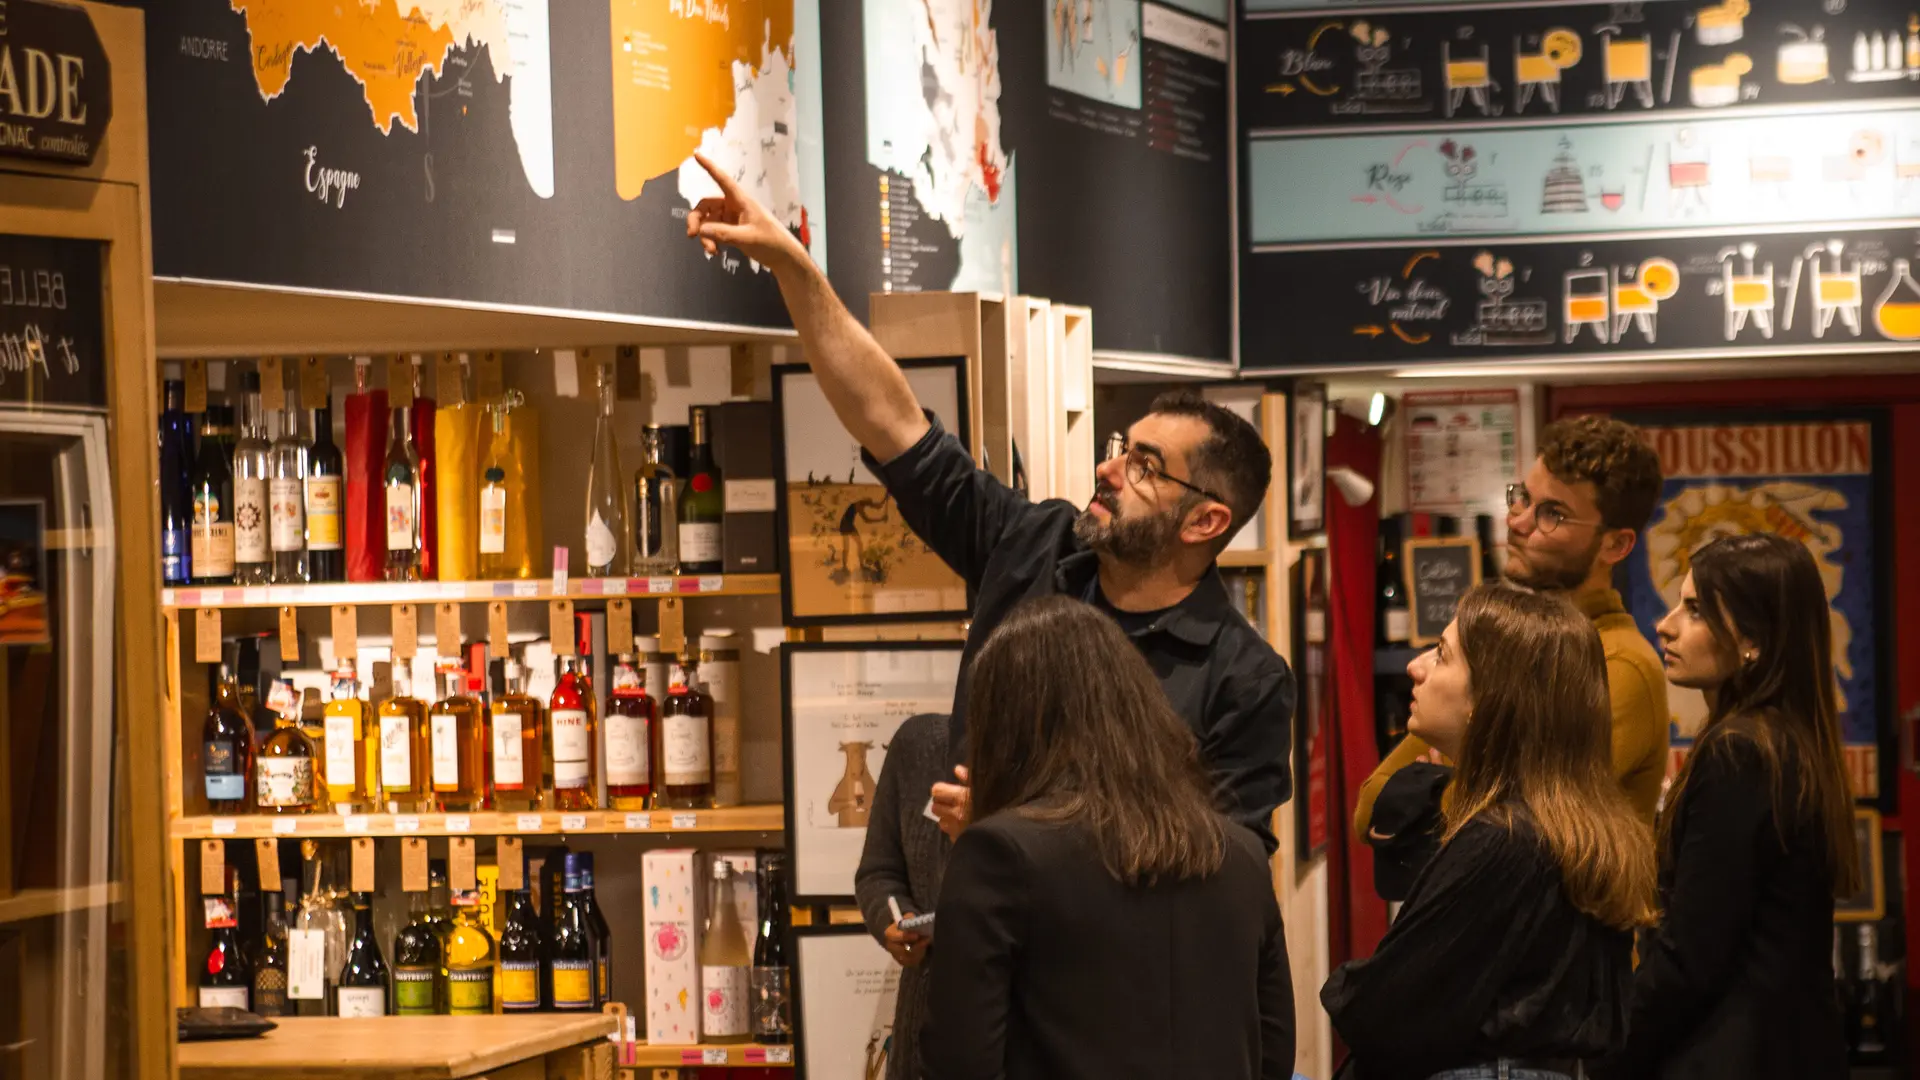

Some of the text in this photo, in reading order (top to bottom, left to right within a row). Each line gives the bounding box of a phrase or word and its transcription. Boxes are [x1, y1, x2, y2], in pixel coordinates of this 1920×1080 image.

[180, 36, 229, 61] ANDORRE
[303, 145, 361, 209] Espagne
[1641, 426, 1870, 476] OUSSILLON
